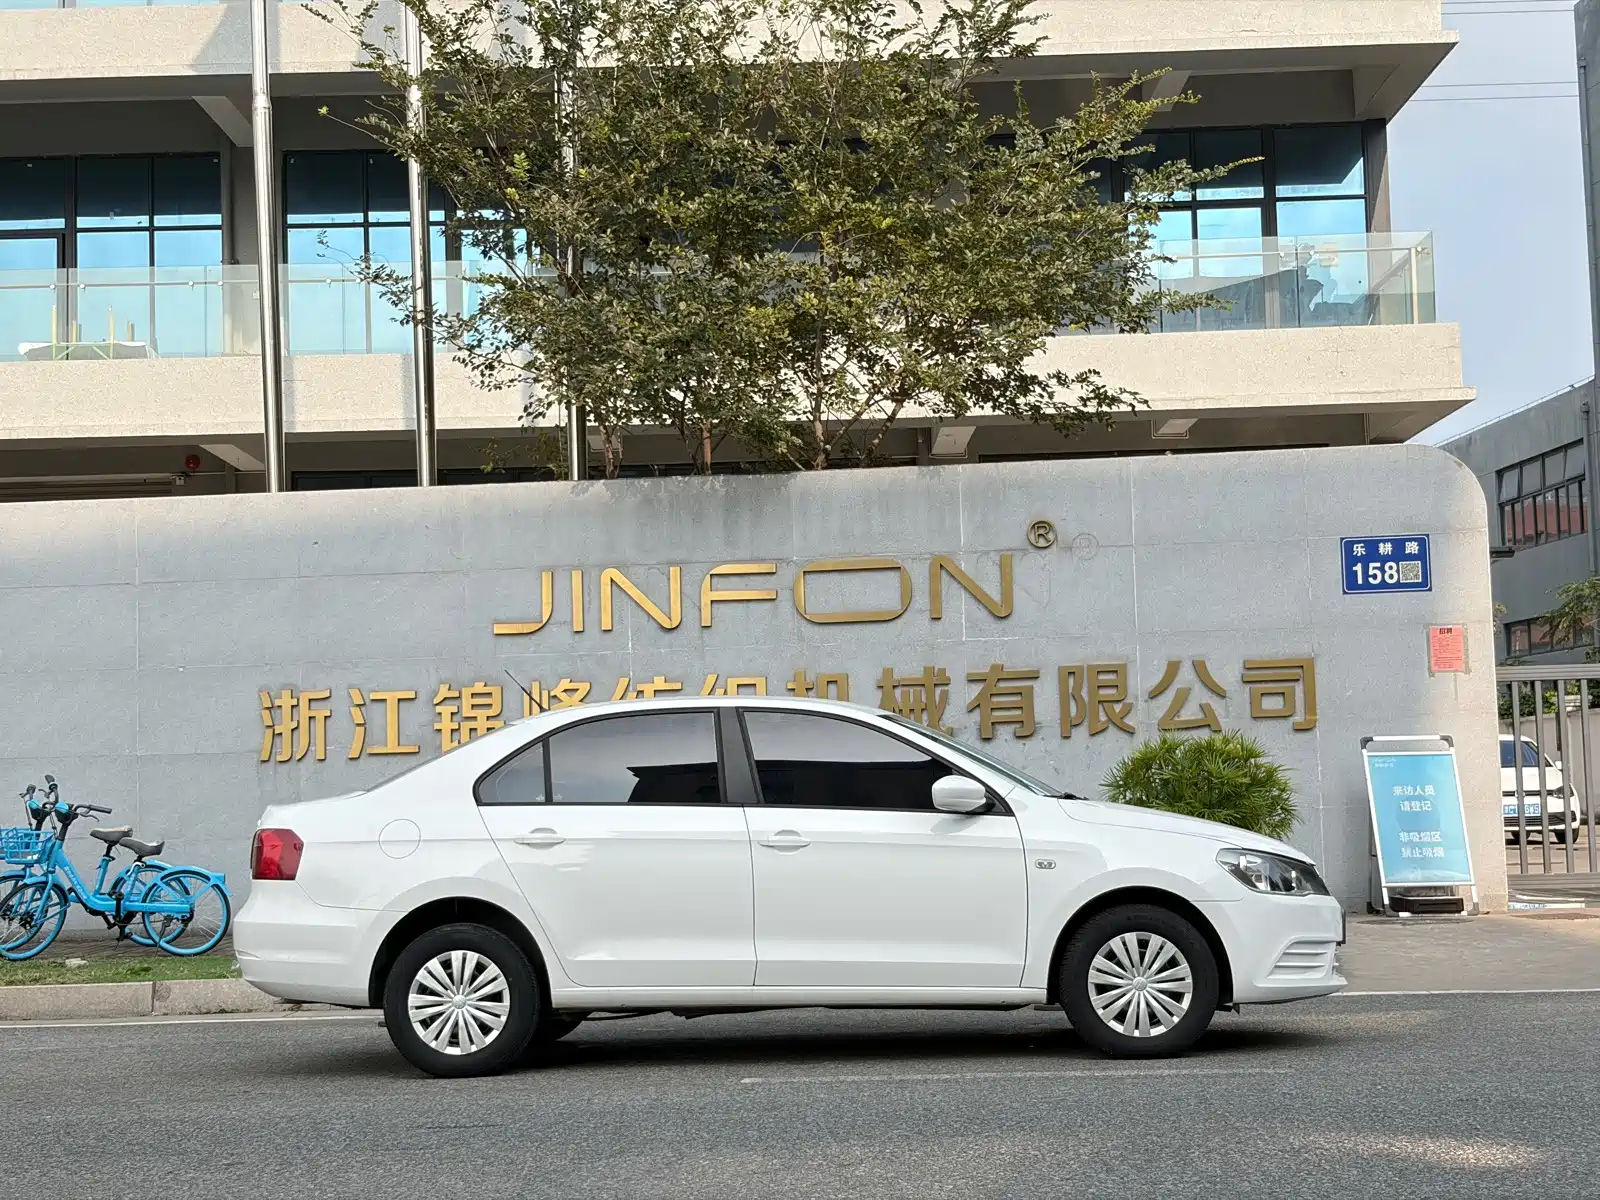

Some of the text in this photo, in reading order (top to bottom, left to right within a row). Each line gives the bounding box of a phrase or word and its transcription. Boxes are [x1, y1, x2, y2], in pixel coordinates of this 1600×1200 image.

[1353, 541, 1419, 556] 乐耕路
[1353, 561, 1398, 584] 158
[493, 553, 1013, 635] JINFON
